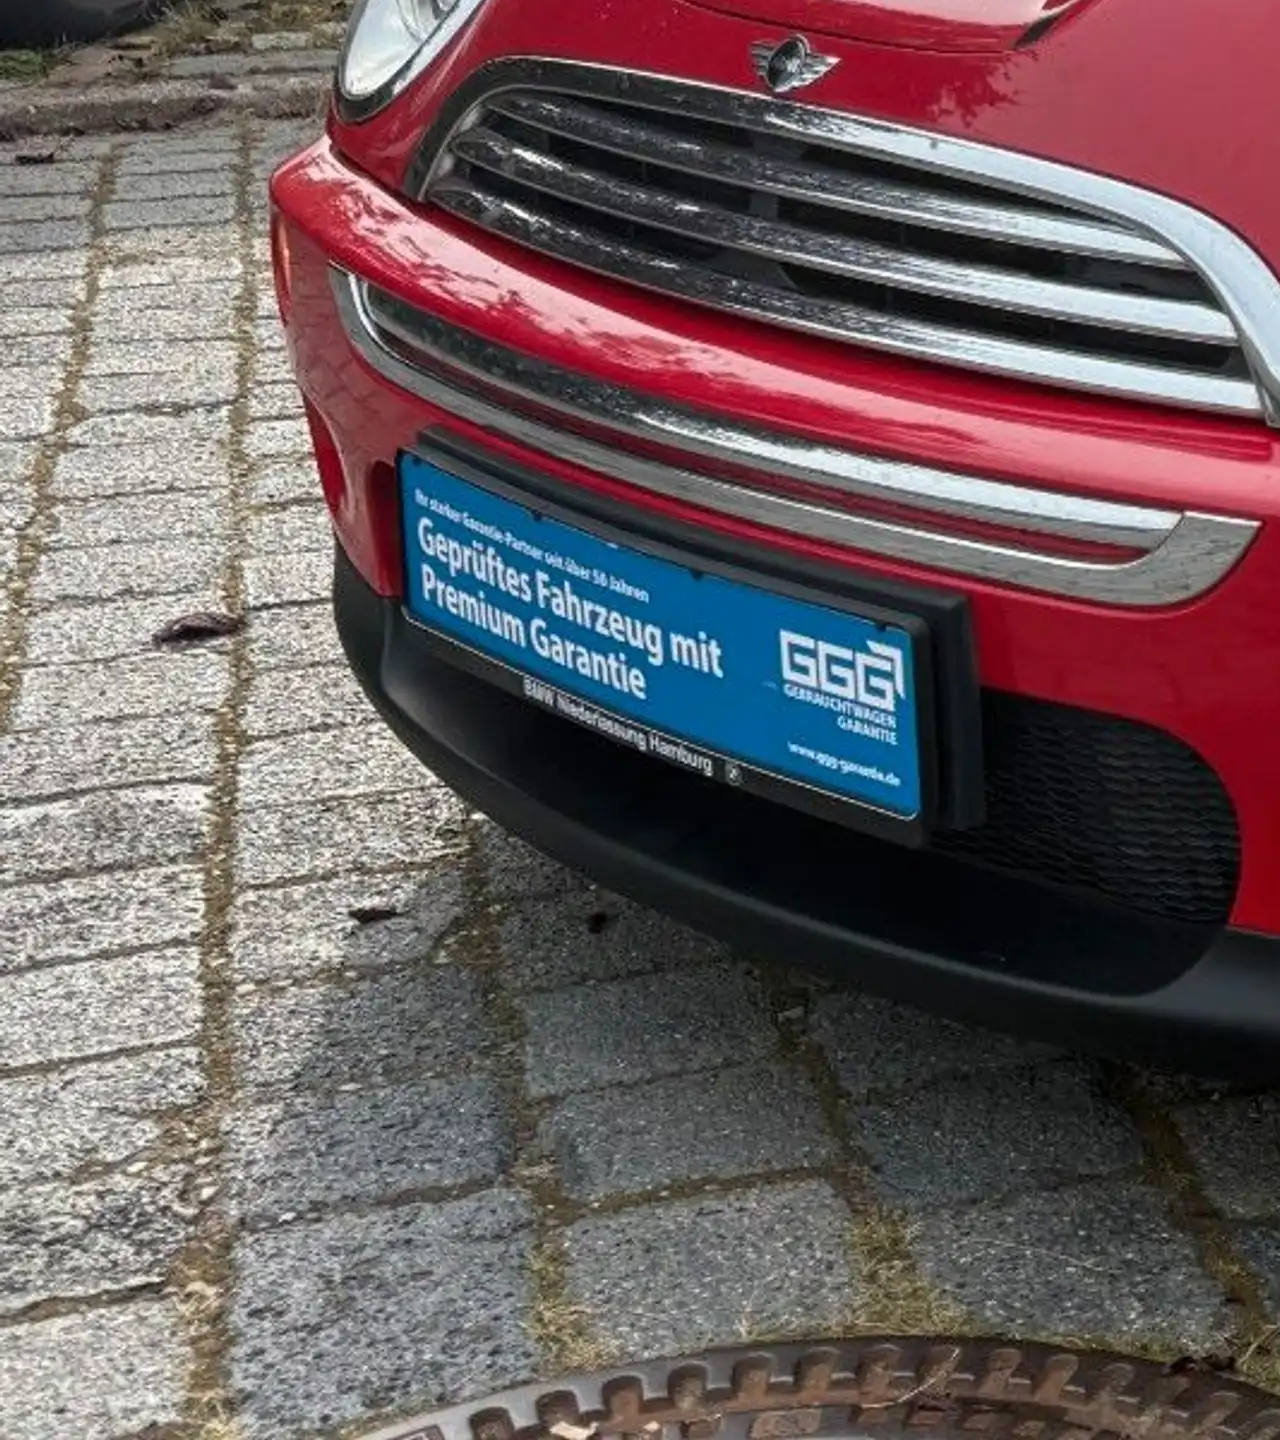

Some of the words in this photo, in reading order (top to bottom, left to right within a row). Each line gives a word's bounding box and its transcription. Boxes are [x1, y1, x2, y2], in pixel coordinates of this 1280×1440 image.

[429, 498, 461, 523] starker
[461, 511, 543, 561] Garantie-Partner
[544, 551, 564, 571] seit
[608, 574, 650, 603] Jahren
[418, 516, 532, 602] Geprüftes
[535, 568, 664, 666] Fahrzeug
[669, 630, 723, 678] mit
[421, 563, 526, 648] Premium
[530, 618, 647, 700] Garantie
[779, 628, 905, 711] GGG
[783, 683, 897, 729] GEBRAUCHTWAGEN
[555, 692, 647, 751] Niederlassung
[648, 731, 713, 777] Hamburg
[837, 715, 898, 746] GARANTIE
